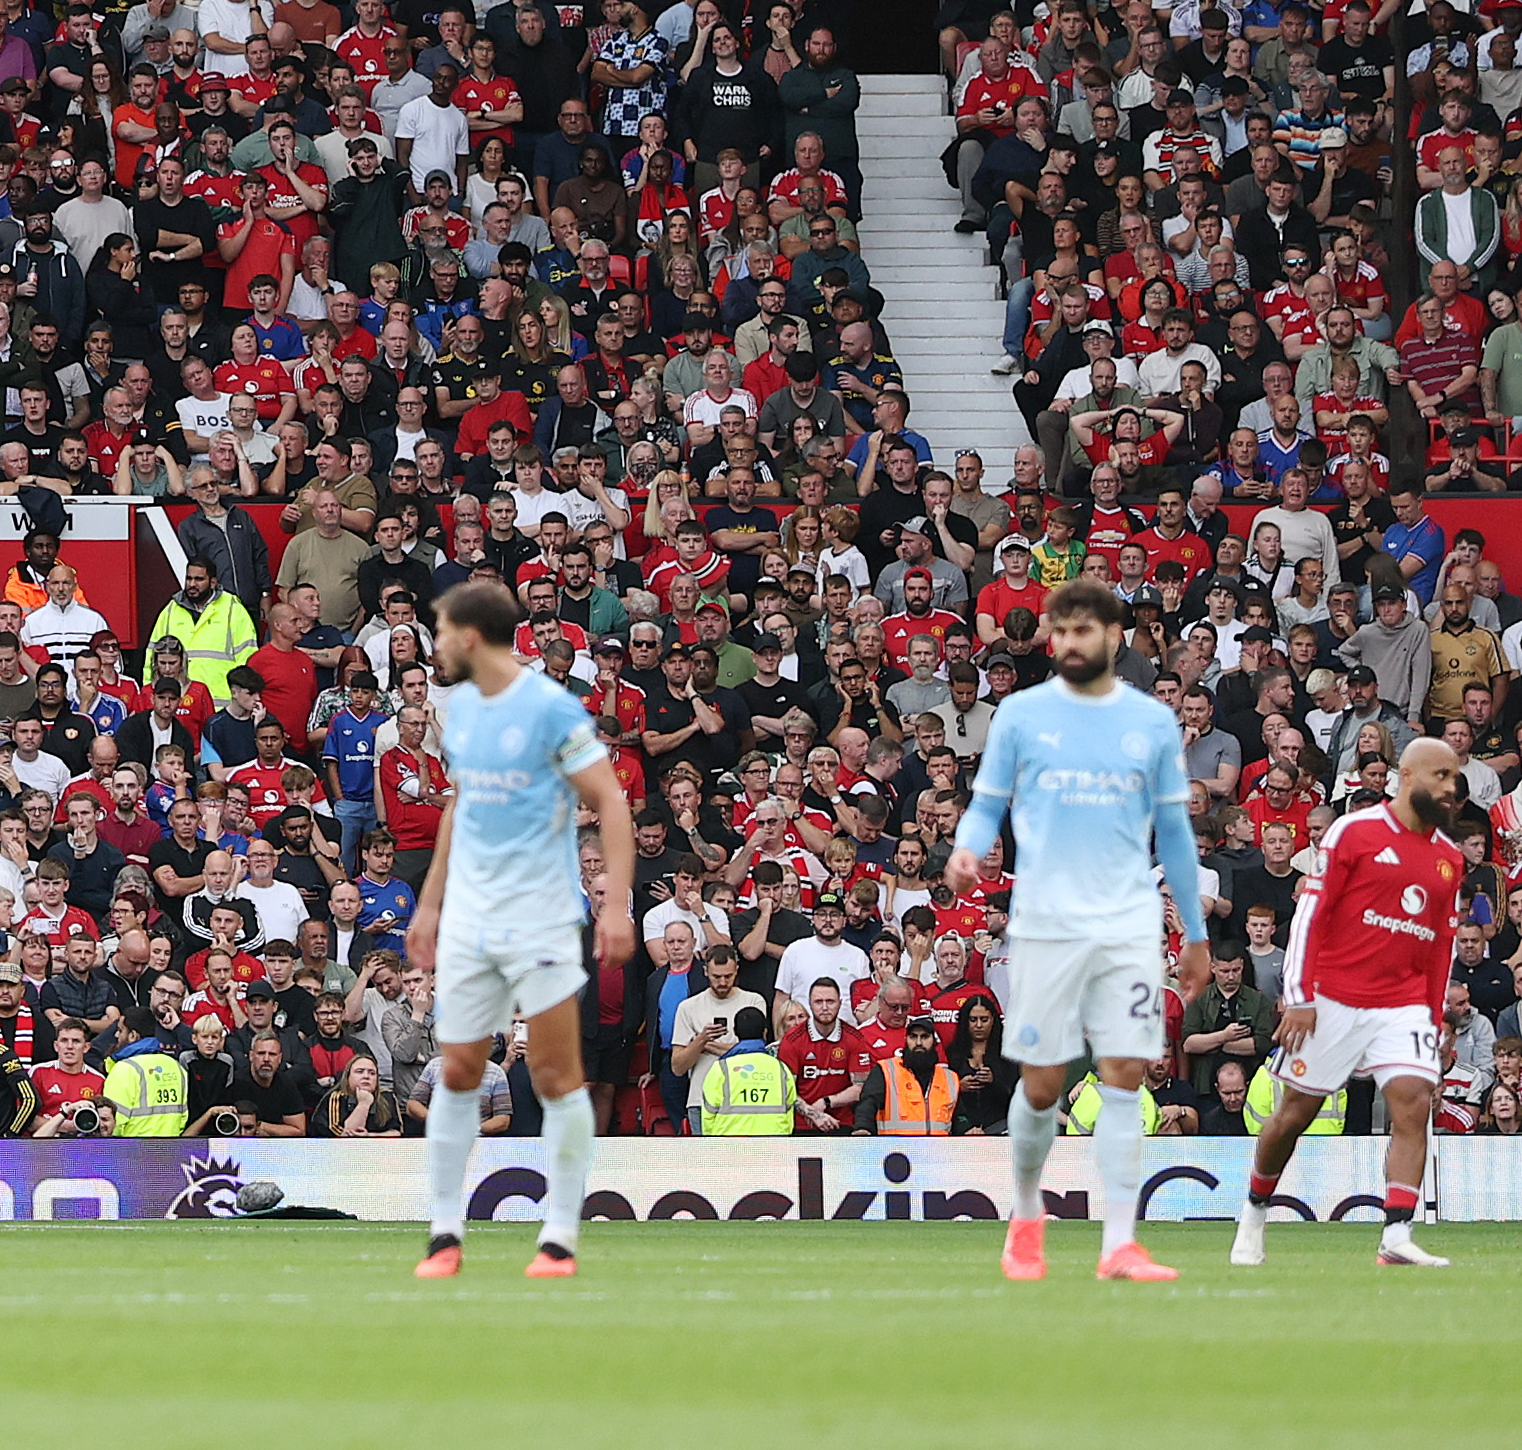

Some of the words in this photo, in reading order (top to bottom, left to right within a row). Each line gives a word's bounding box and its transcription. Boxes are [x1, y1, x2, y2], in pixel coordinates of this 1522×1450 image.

[713, 95, 751, 106] CHRIS
[1037, 768, 1145, 792] ETIHAD
[1410, 1031, 1437, 1061] 19
[156, 1089, 178, 1104] 393
[740, 1088, 769, 1104] 167
